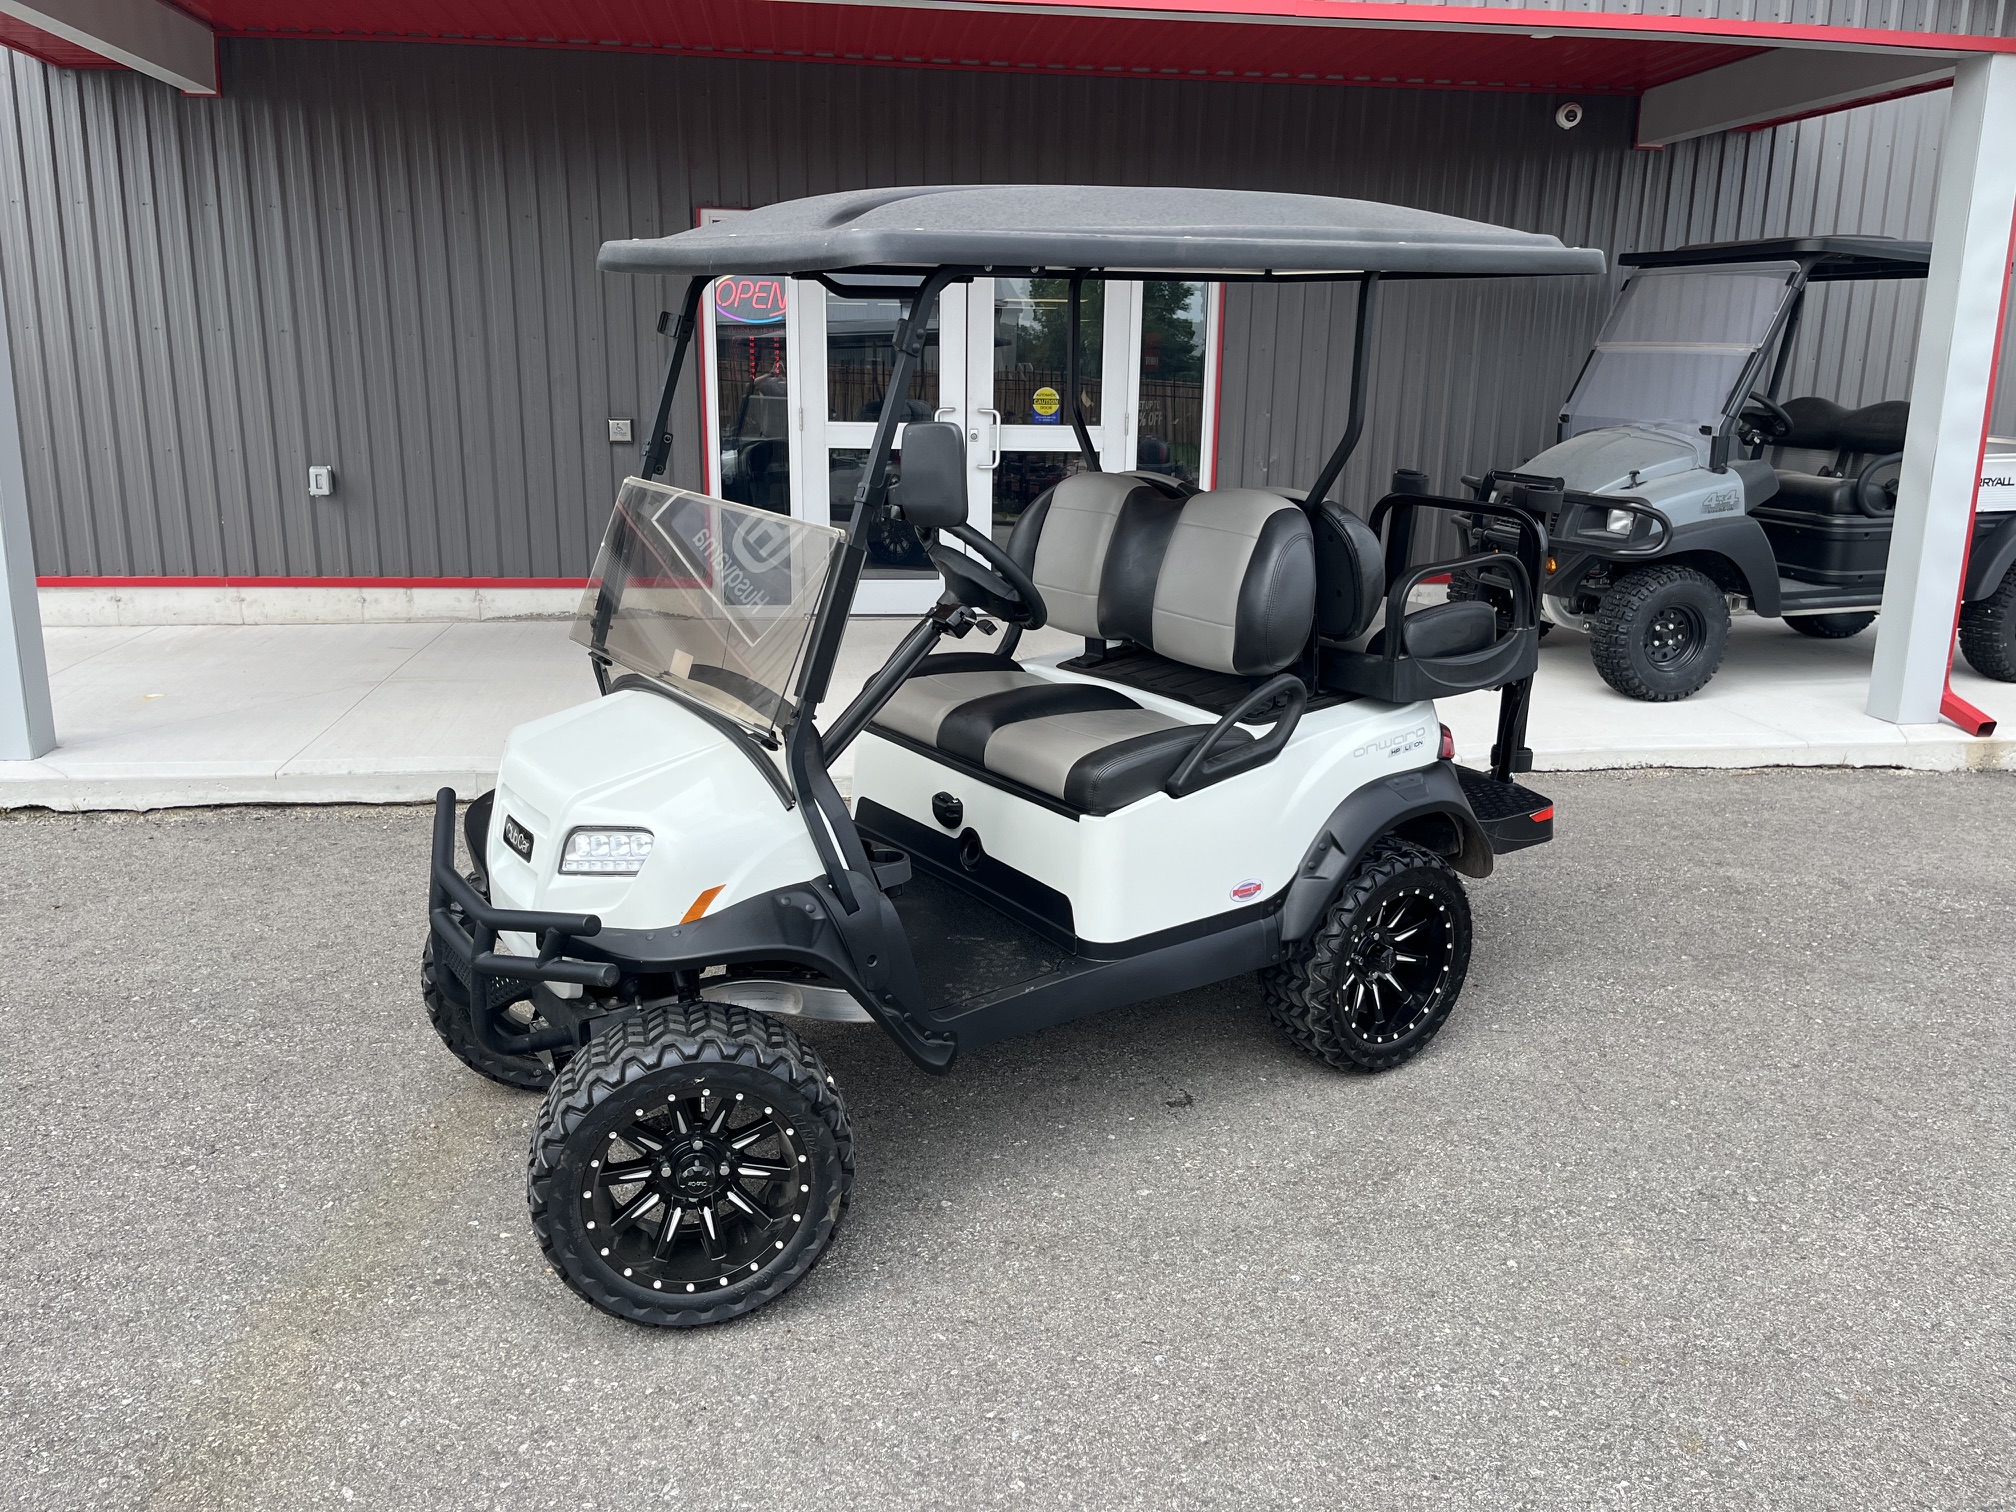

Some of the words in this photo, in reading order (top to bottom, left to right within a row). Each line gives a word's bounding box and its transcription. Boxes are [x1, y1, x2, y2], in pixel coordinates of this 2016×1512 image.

[716, 280, 787, 309] OPEN
[506, 822, 518, 845] Club
[517, 833, 530, 854] Car
